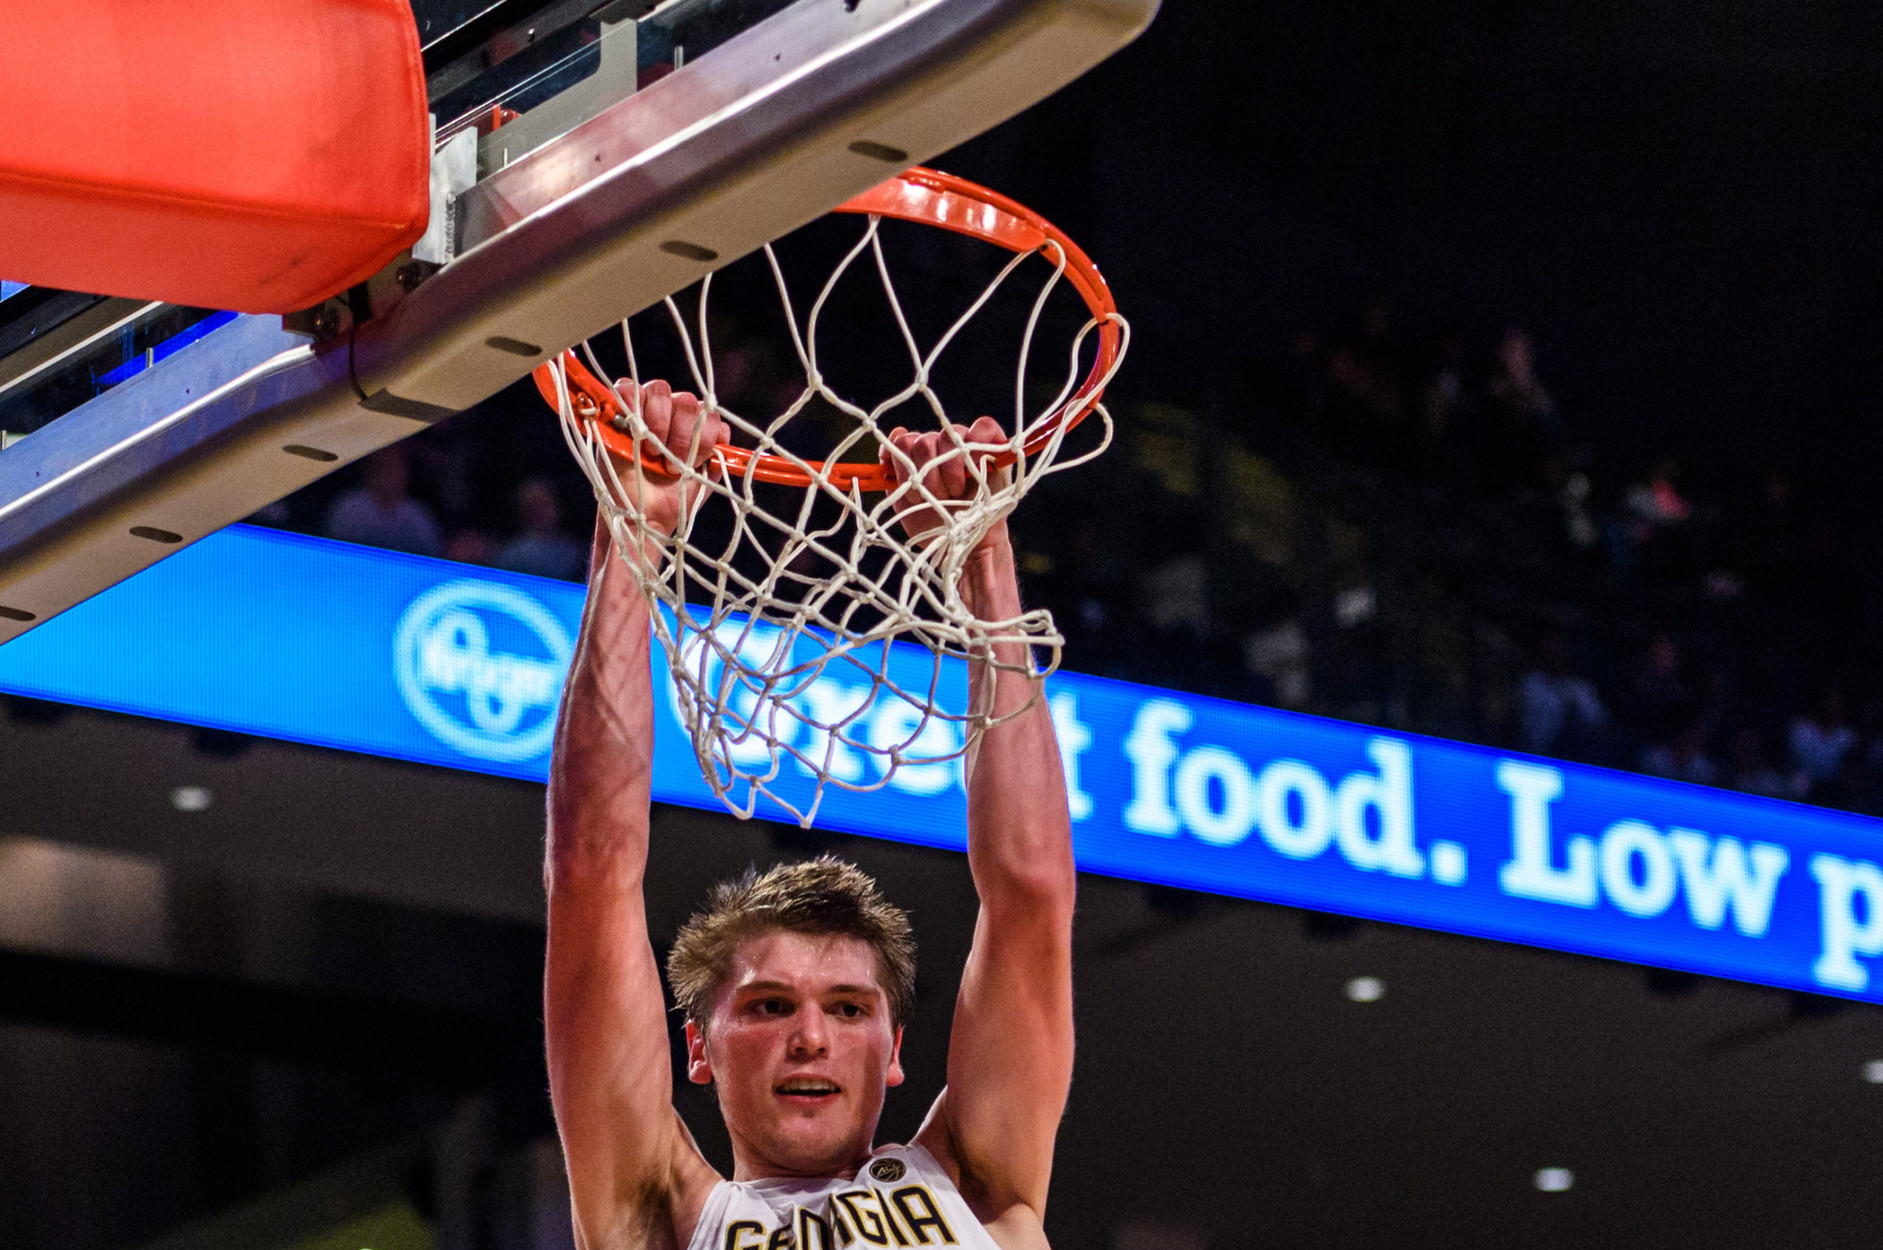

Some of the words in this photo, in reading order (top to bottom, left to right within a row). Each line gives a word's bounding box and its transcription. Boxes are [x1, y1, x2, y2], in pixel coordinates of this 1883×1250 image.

[670, 615, 1094, 822] Gret
[1122, 697, 1468, 886] food.
[1495, 758, 1789, 938] Low
